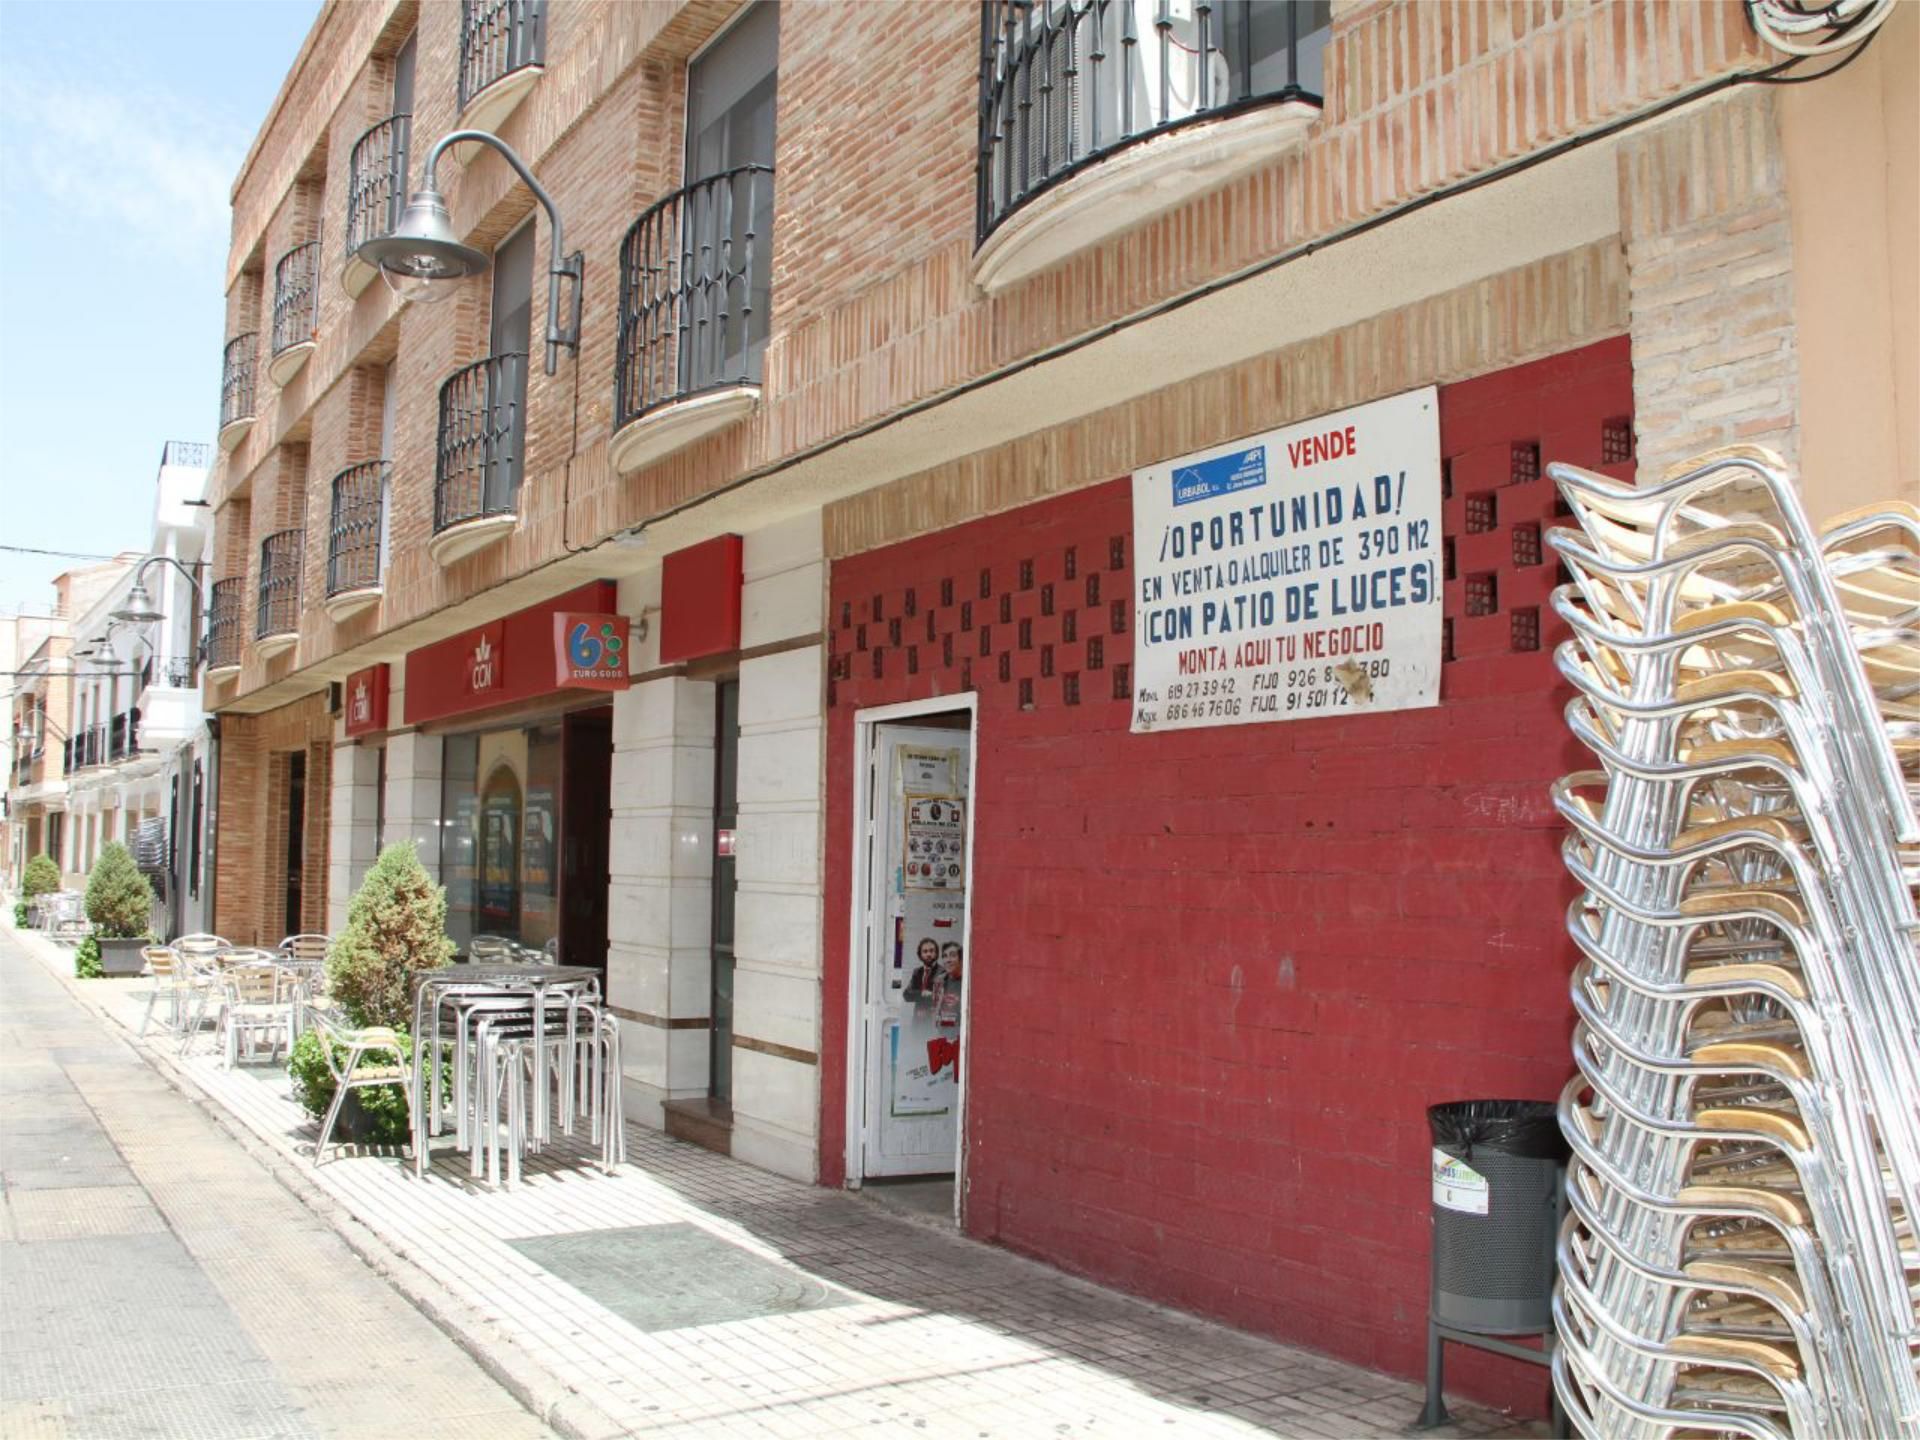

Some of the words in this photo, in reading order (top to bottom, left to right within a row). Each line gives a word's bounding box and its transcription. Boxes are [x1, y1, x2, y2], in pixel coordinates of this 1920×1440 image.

[1287, 426, 1356, 469] VENDE
[1142, 576, 1162, 602] EN
[1172, 565, 1224, 597] VENTA
[1242, 544, 1311, 584] ALQUILER
[1319, 537, 1344, 568] DE
[1359, 526, 1399, 560] 390
[1408, 519, 1429, 551] M2
[1144, 605, 1192, 648] (CON
[1203, 591, 1275, 635] PATIO
[1286, 583, 1319, 623] DE
[1332, 559, 1435, 616] LUCES)
[1179, 646, 1227, 675] MONTA
[1234, 639, 1271, 669] AQUI
[1276, 635, 1296, 664] TU
[1303, 622, 1384, 661] NEGOCIO
[473, 662, 492, 690] CCM
[574, 670, 597, 678] EURO
[1252, 672, 1279, 691] FIJO
[1287, 667, 1317, 688] 926
